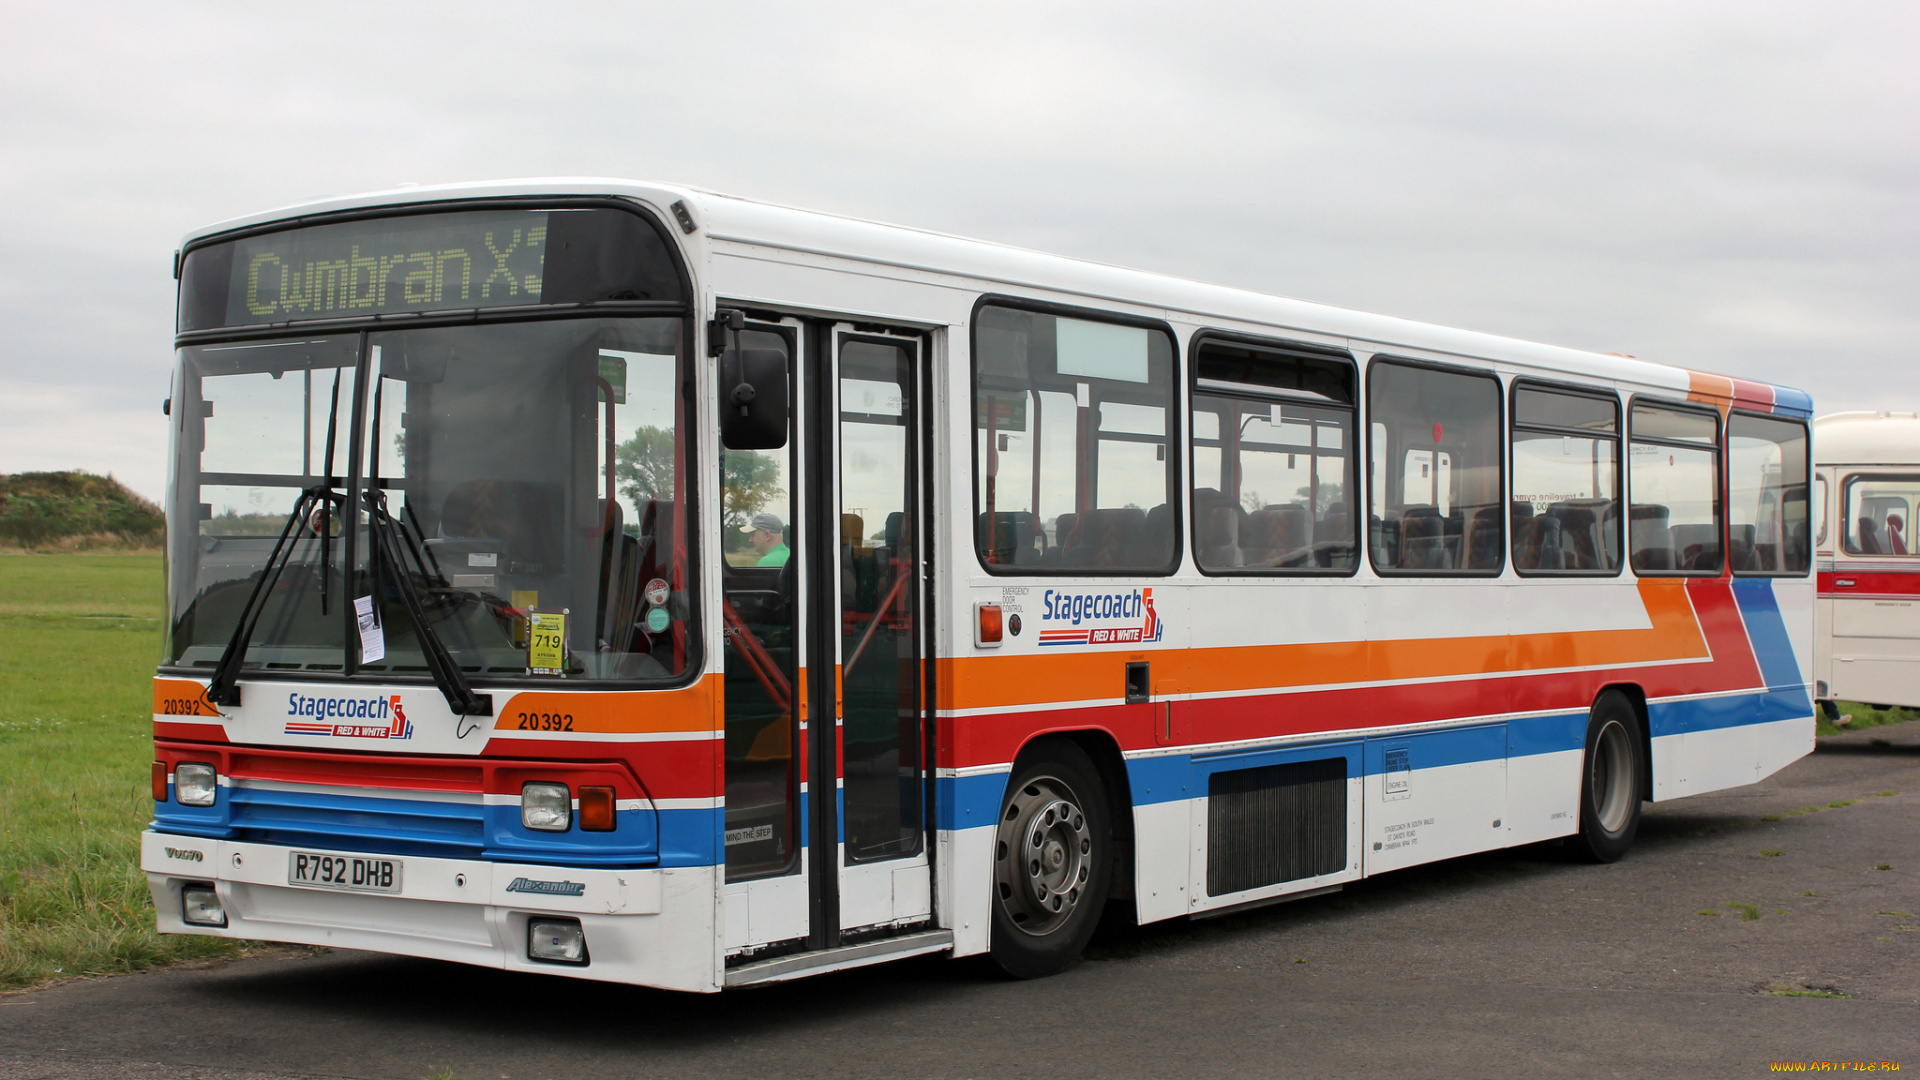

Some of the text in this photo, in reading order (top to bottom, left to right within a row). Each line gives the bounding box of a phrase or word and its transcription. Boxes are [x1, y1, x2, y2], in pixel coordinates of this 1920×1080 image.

[247, 244, 471, 315] Cwmbran
[1003, 587, 1030, 595] EMERGENCY
[1003, 596, 1015, 604] DOOR
[1043, 589, 1142, 625] Stagecoach
[1003, 604, 1023, 613] CONTROL
[535, 634, 561, 649] 719
[1093, 629, 1140, 642] RED & WHITE
[163, 698, 200, 716] 20392
[288, 692, 388, 721] Stagecoach
[518, 712, 574, 732] 20392
[336, 726, 387, 737] RED & WHITE
[725, 828, 771, 842] MIND THE STEP
[165, 847, 203, 862] VOLVO
[296, 855, 393, 888] R792 DHB
[506, 877, 585, 896] Alexander
